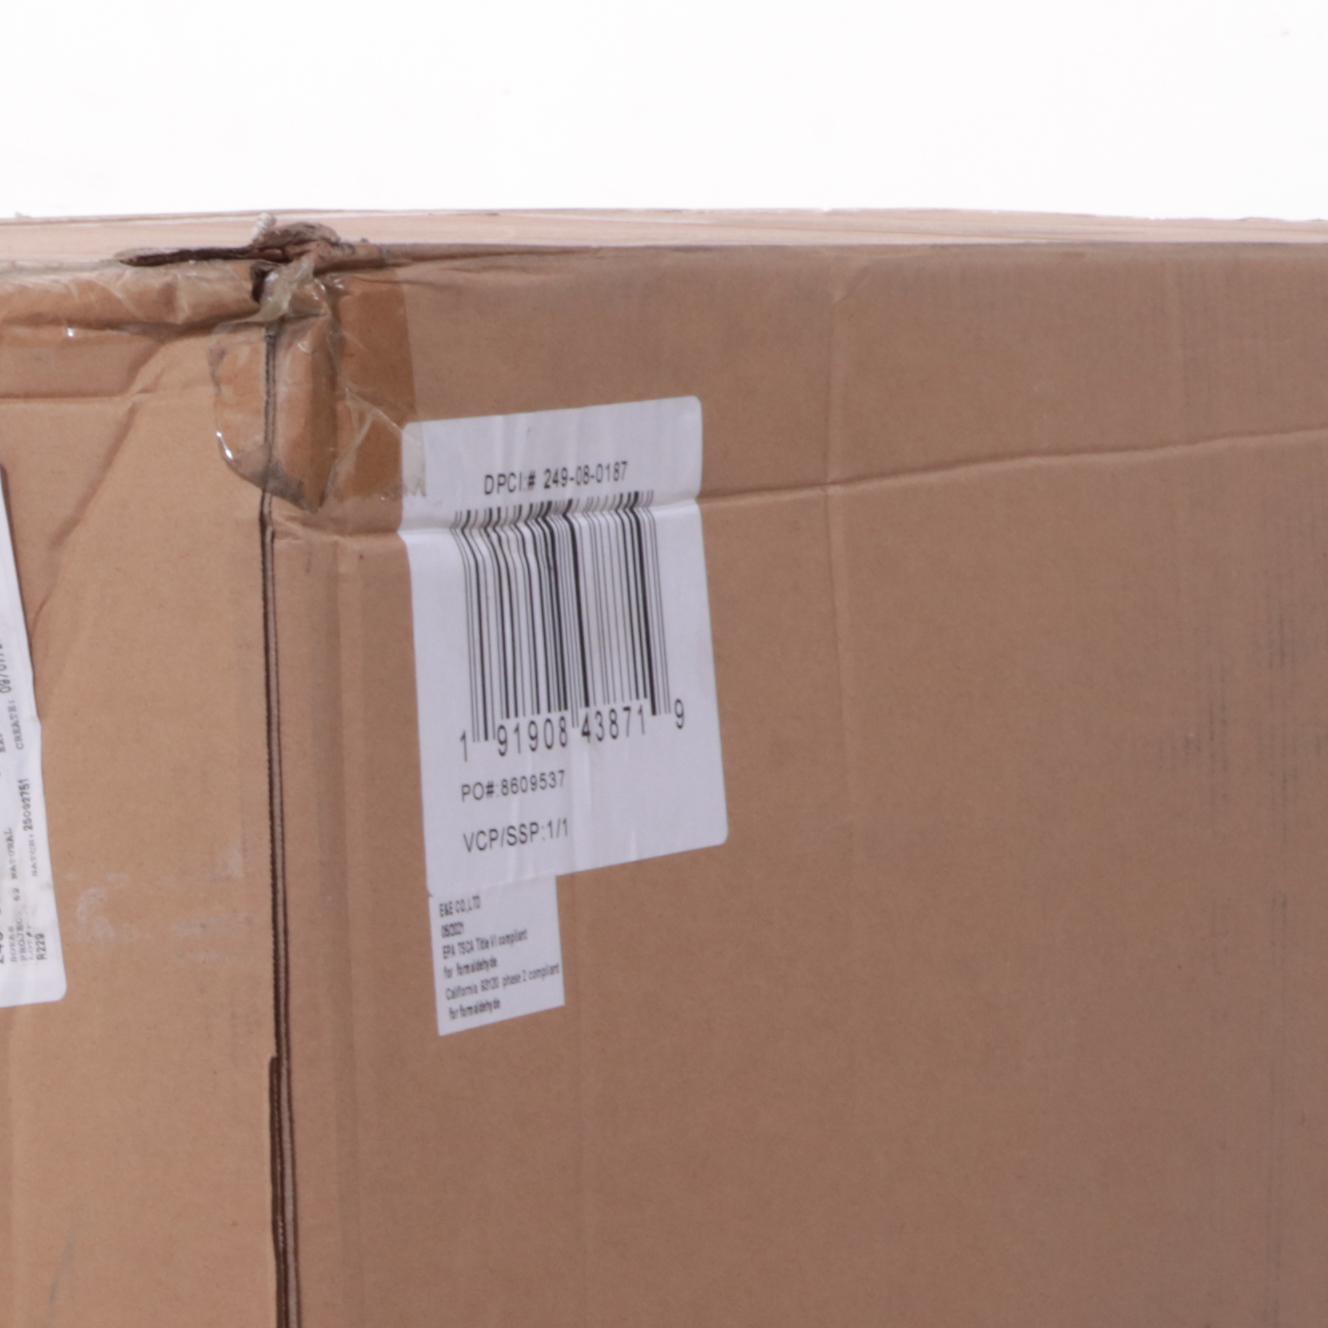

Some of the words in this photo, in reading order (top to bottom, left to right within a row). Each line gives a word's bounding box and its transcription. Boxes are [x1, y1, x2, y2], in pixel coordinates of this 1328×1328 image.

[543, 461, 628, 489] 249-08-0187
[460, 729, 468, 762] 1
[497, 716, 569, 757] 91908
[581, 704, 646, 744] 43871
[674, 698, 685, 730] 9
[463, 817, 569, 853] VCP/SSP:1/1
